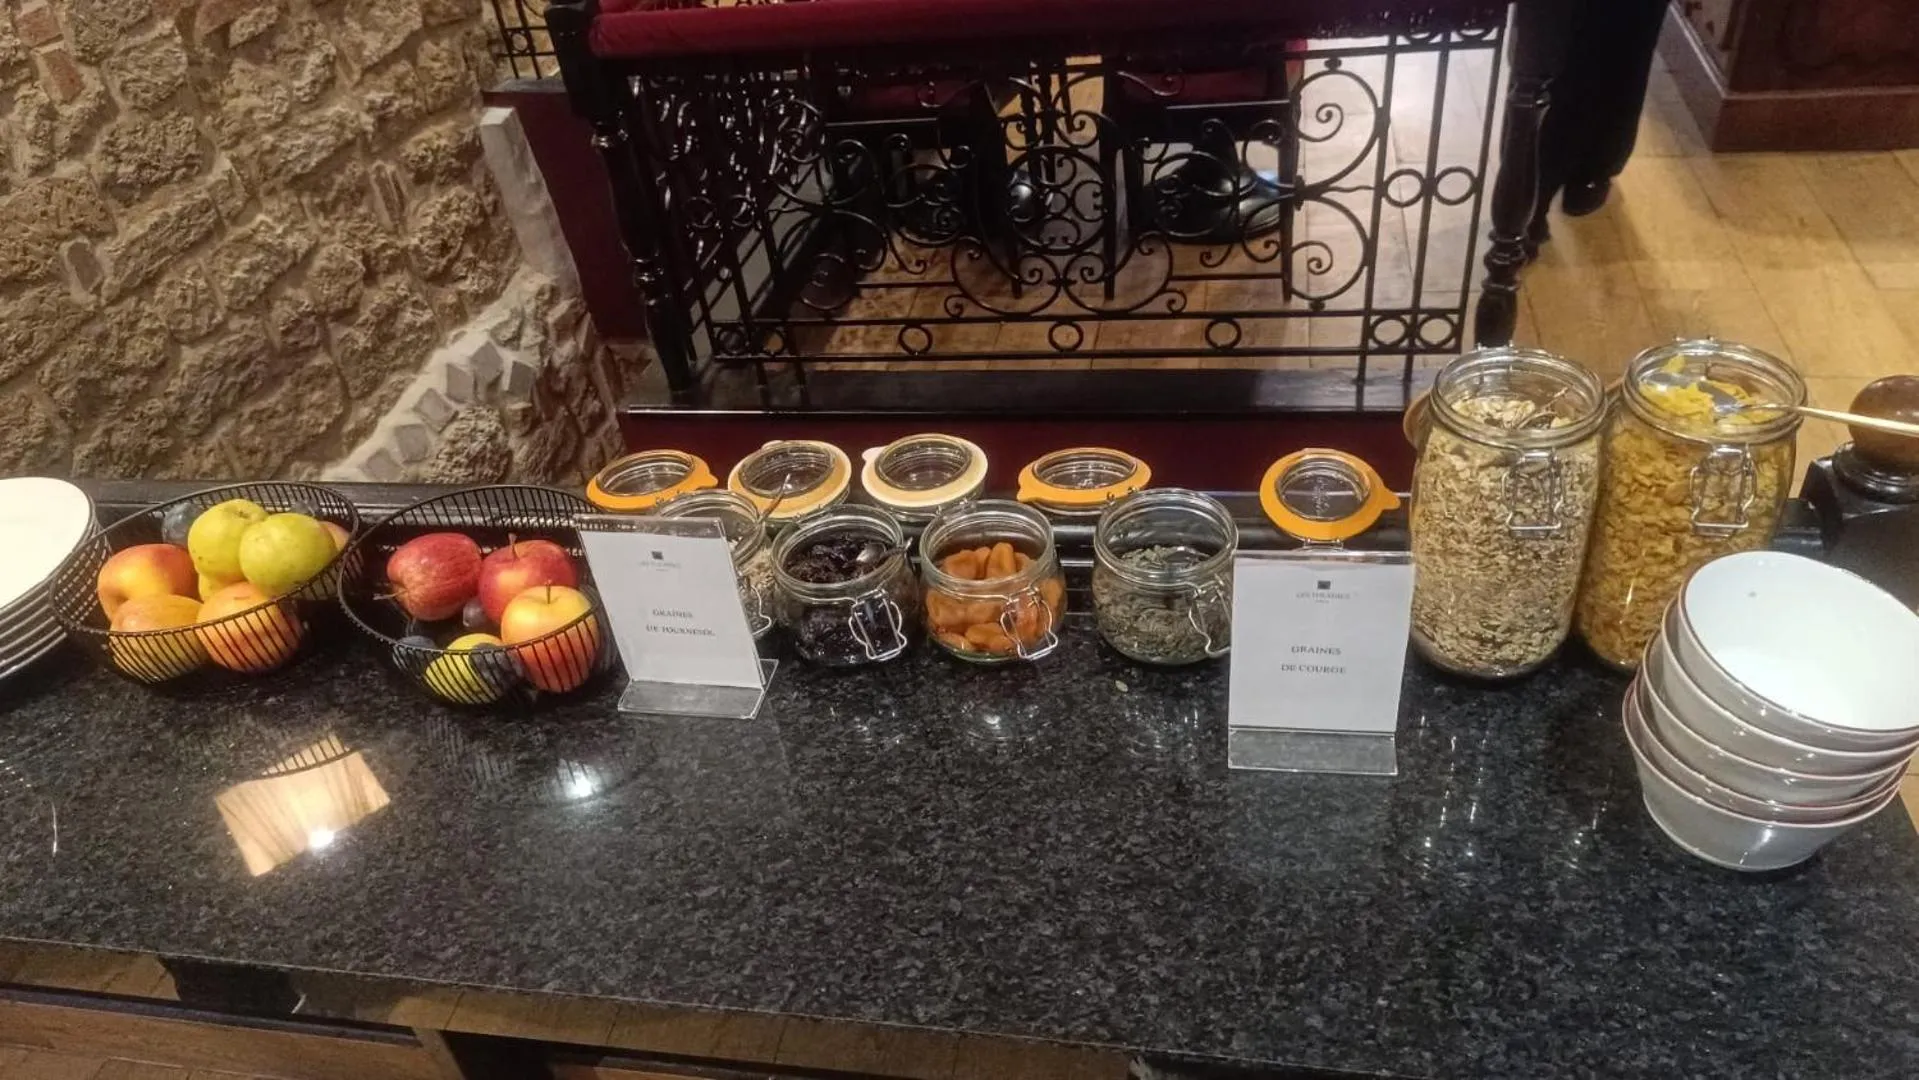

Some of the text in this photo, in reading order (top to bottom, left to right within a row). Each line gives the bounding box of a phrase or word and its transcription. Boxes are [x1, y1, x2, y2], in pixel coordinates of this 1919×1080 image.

[1291, 645, 1341, 656] GRAINES
[1281, 663, 1347, 674] DE COURGE
